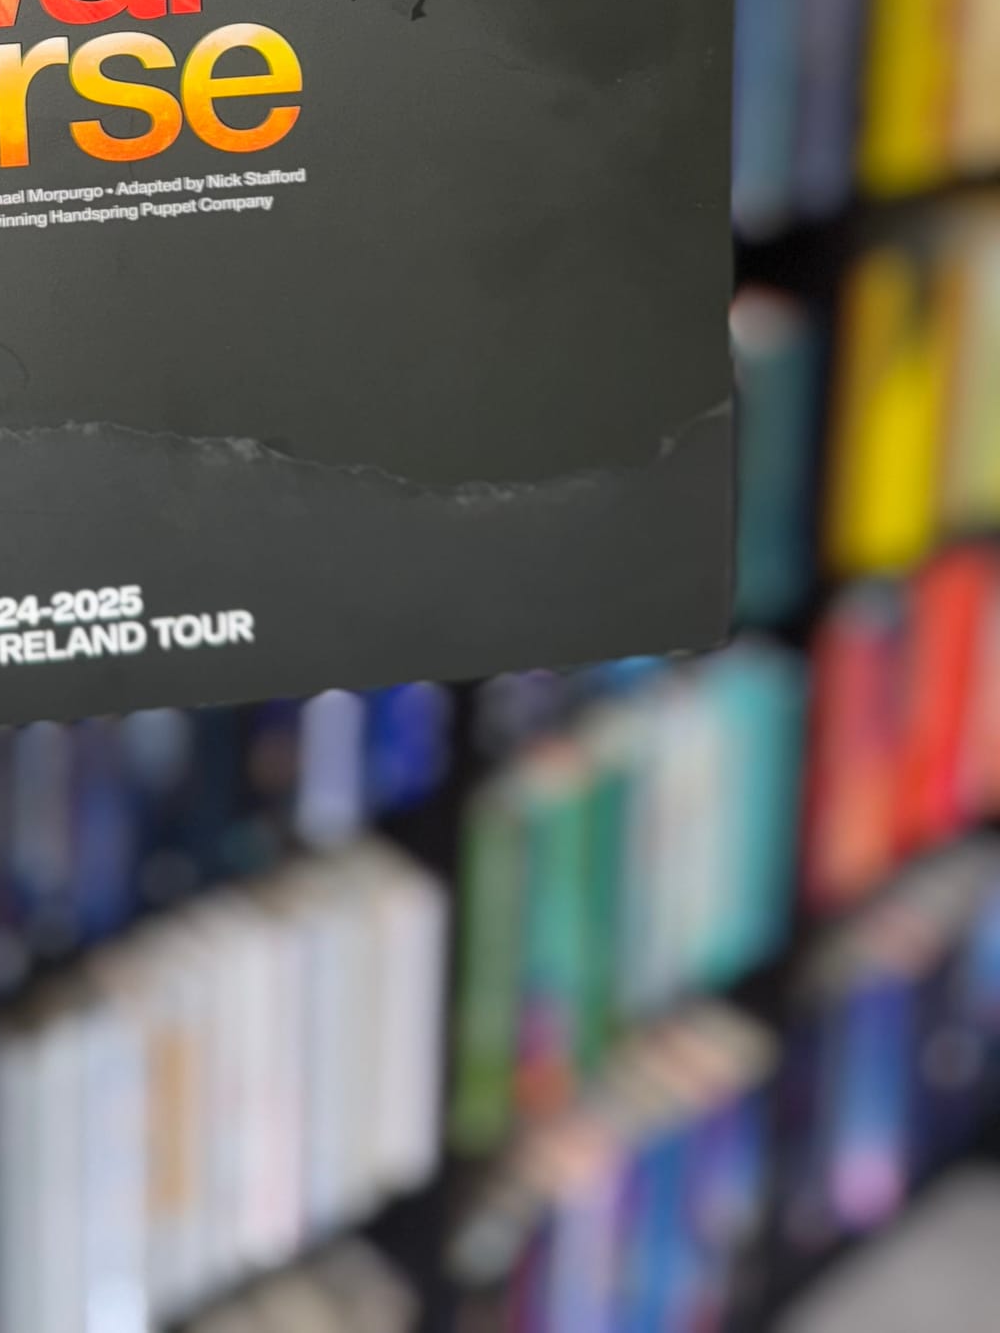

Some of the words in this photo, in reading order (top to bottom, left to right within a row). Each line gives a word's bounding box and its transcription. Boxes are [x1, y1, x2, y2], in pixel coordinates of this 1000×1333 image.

[26, 186, 104, 204] Morpurgo
[115, 178, 183, 197] Adapted
[184, 176, 205, 193] by
[206, 173, 242, 189] Nick
[243, 168, 307, 185] Stafford
[49, 205, 139, 226] Handspring
[140, 200, 197, 218] Puppet
[198, 195, 275, 212] Company
[150, 609, 256, 651] TOUR
